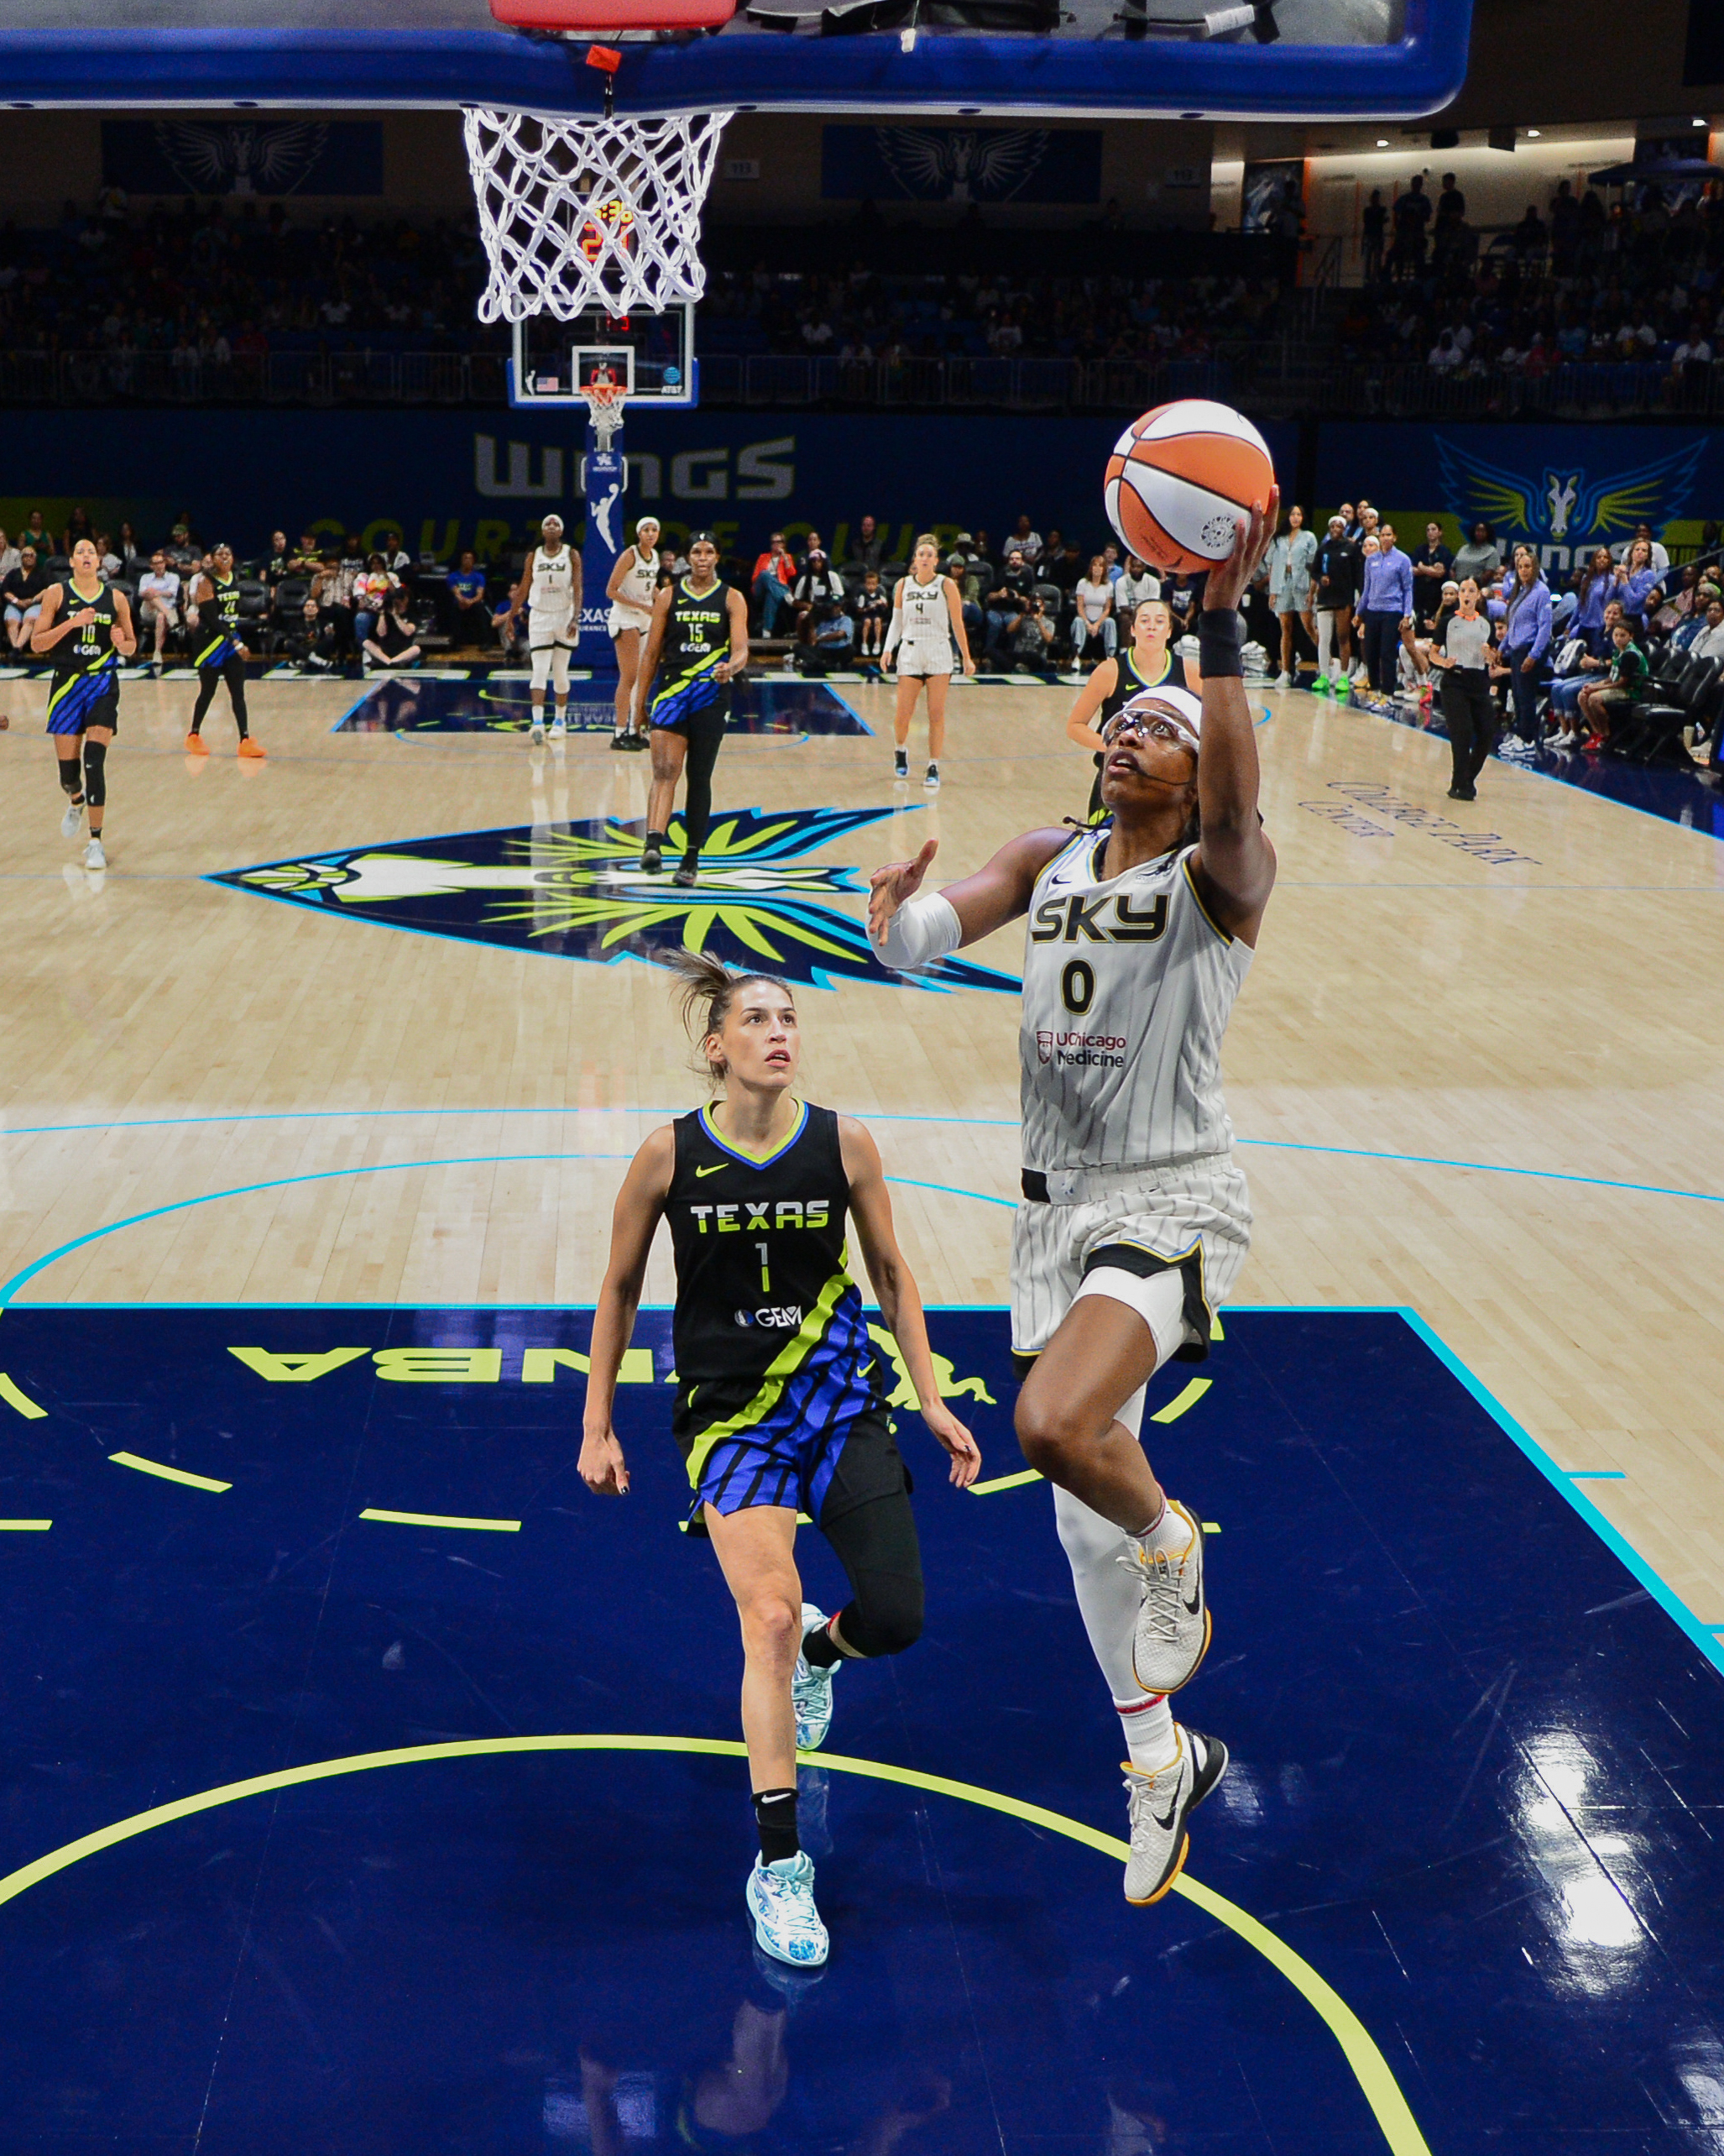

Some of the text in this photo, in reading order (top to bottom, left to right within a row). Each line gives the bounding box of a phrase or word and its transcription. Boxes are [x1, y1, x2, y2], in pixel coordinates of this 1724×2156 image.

[307, 518, 741, 564] COURDE
[906, 590, 938, 602] SKY
[67, 610, 112, 625] TAS
[675, 610, 721, 624] TEXAS
[916, 602, 924, 615] 4
[81, 624, 97, 644] 10
[688, 623, 704, 643] 15
[1031, 892, 1173, 944] SKY
[1059, 956, 1097, 1017] 0
[1056, 1032, 1127, 1051] UChicago
[690, 1200, 830, 1233] TEXAS
[755, 1243, 771, 1293] 1
[755, 1306, 802, 1327] GEM
[227, 1347, 681, 1384] NBA
